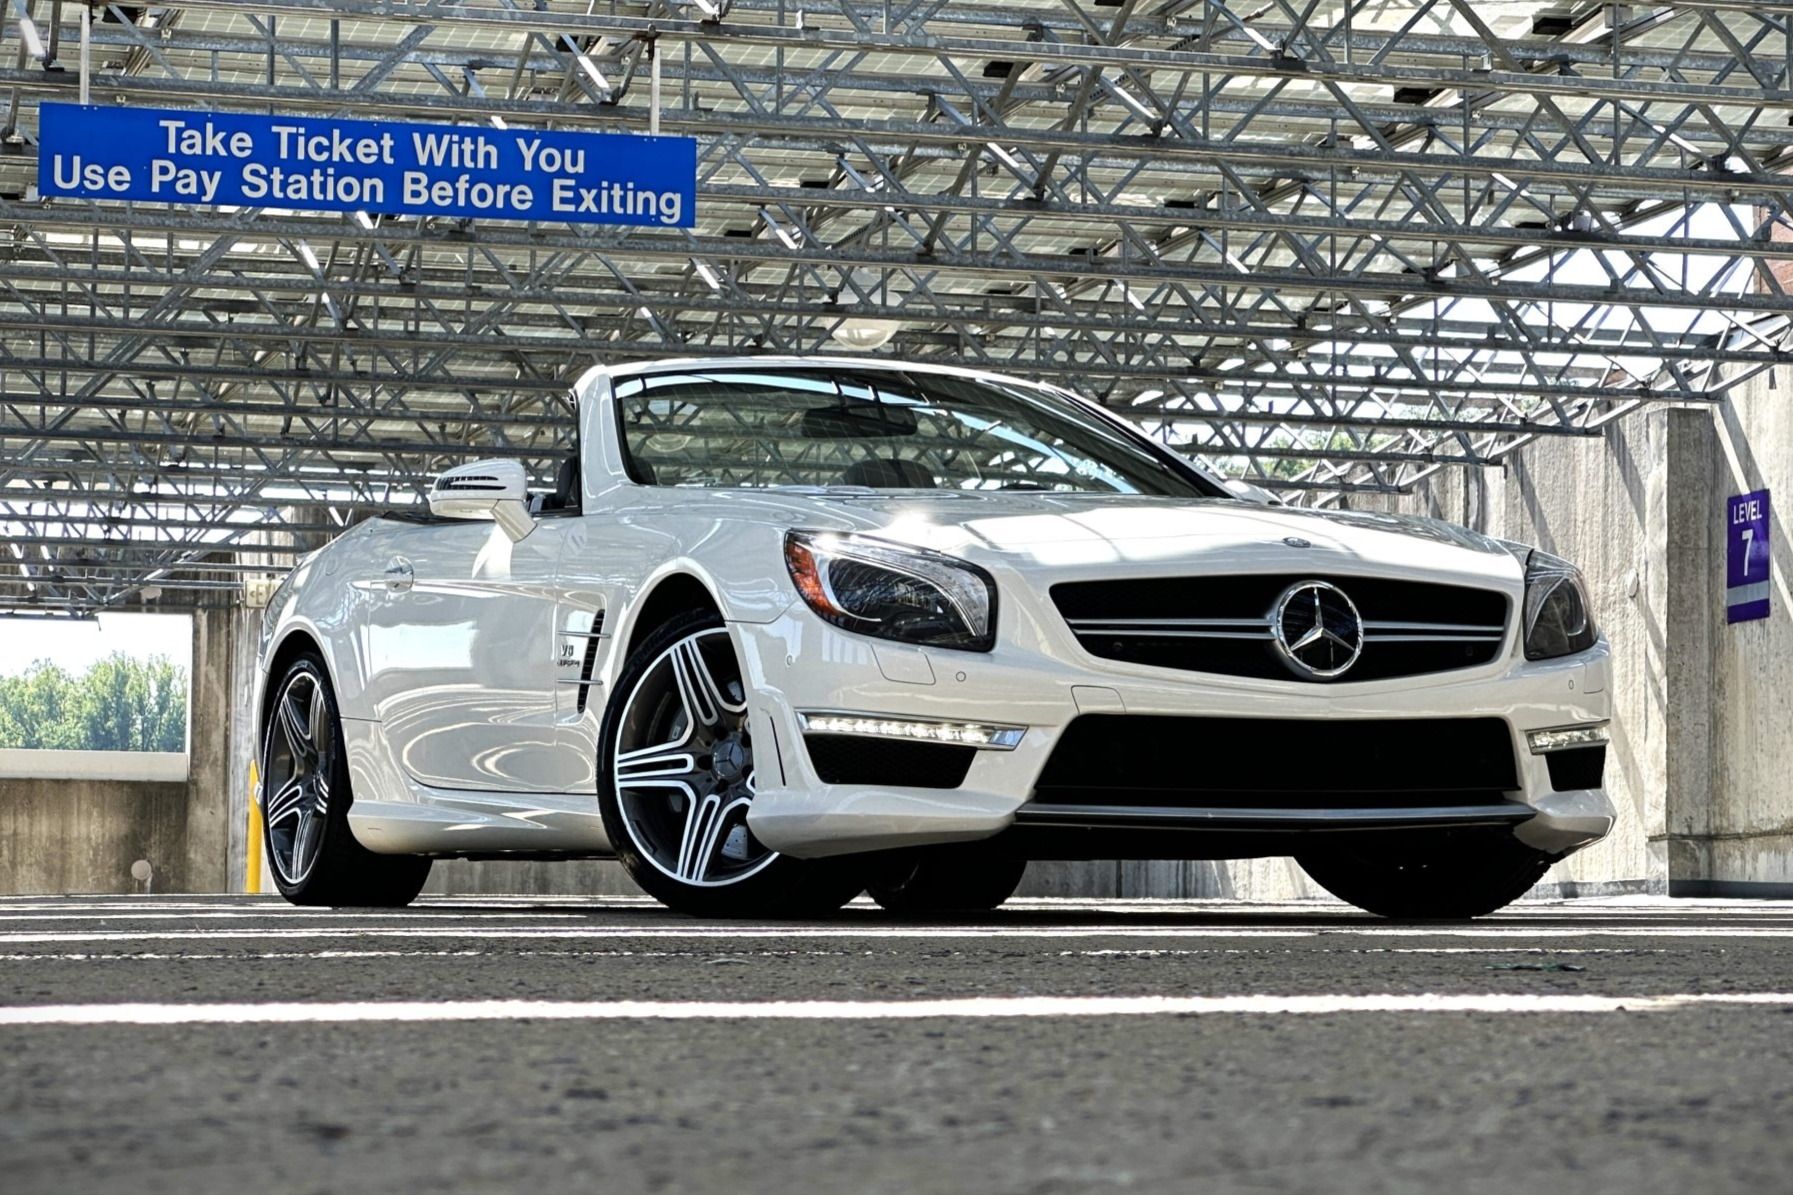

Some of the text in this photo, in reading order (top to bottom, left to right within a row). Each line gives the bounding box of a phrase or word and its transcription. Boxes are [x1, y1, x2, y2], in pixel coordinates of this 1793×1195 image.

[159, 120, 586, 174] Take Ticket With You
[53, 154, 682, 225] Use Pay Station Before Exiting
[1733, 500, 1763, 524] LEVEL
[1741, 528, 1754, 577] 7
